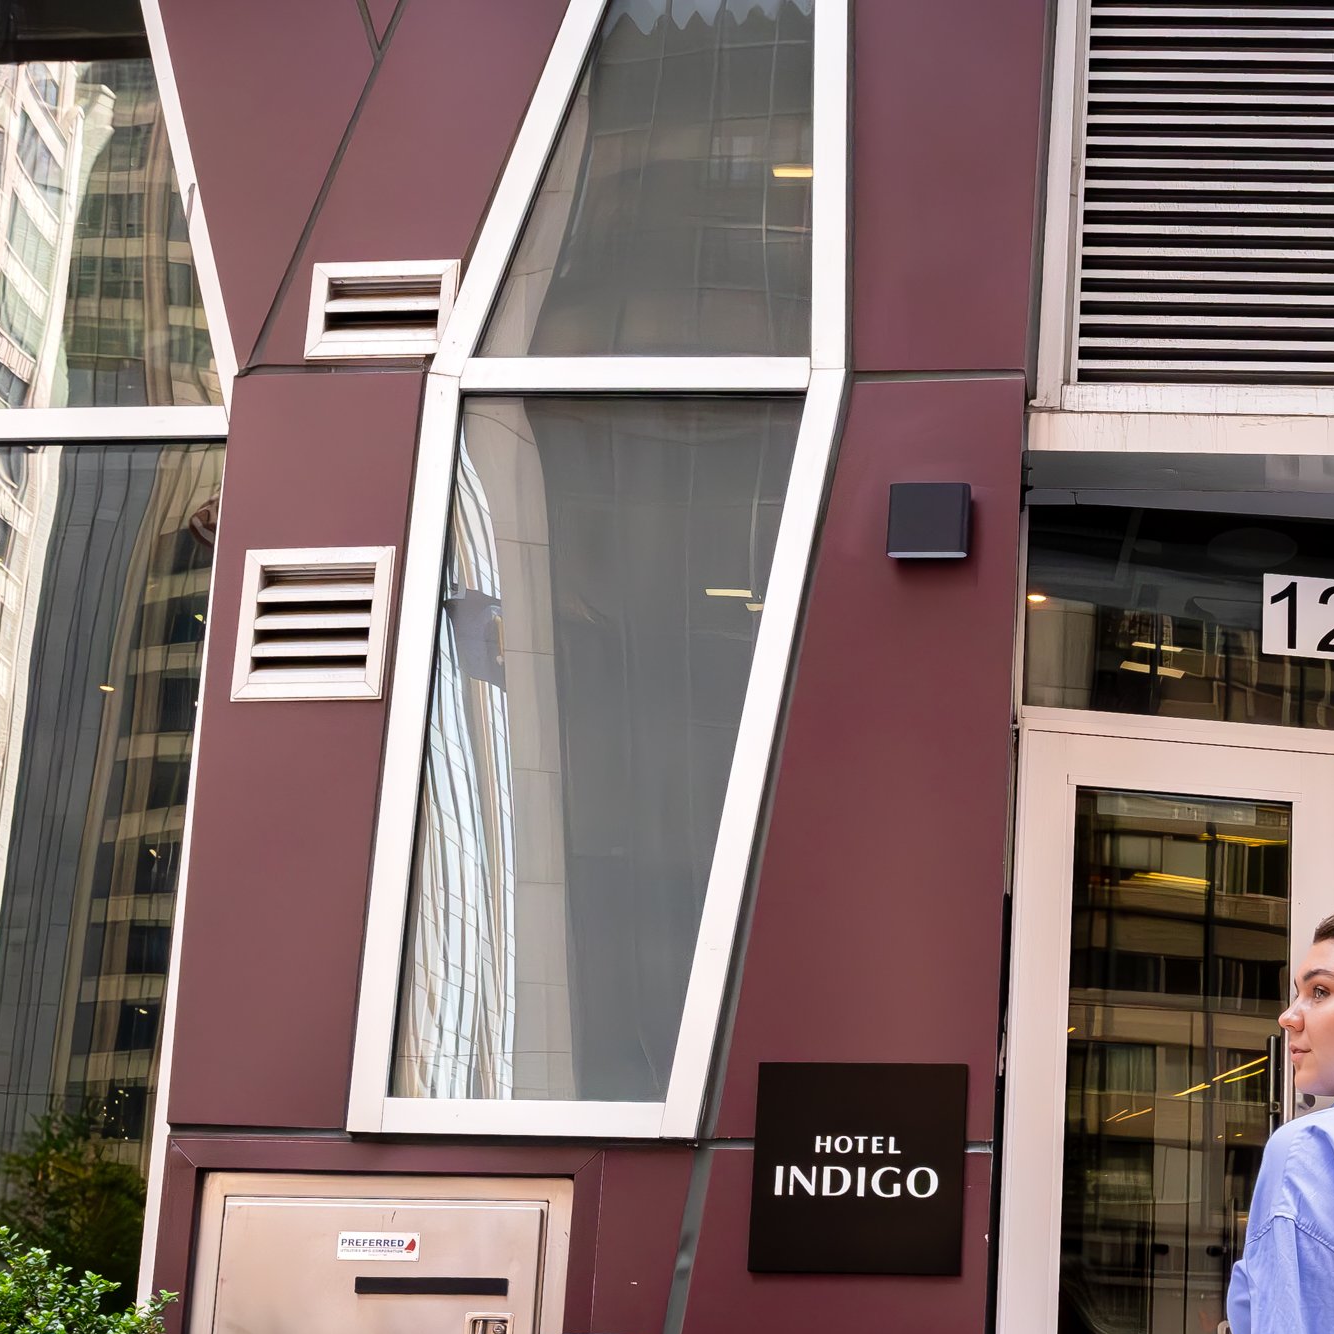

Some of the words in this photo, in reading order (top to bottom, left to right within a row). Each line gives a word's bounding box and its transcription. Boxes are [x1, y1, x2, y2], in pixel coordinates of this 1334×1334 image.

[814, 1135, 902, 1154] HOTEL
[773, 1165, 939, 1198] INDIGO
[340, 1238, 405, 1247] PREFERRED
